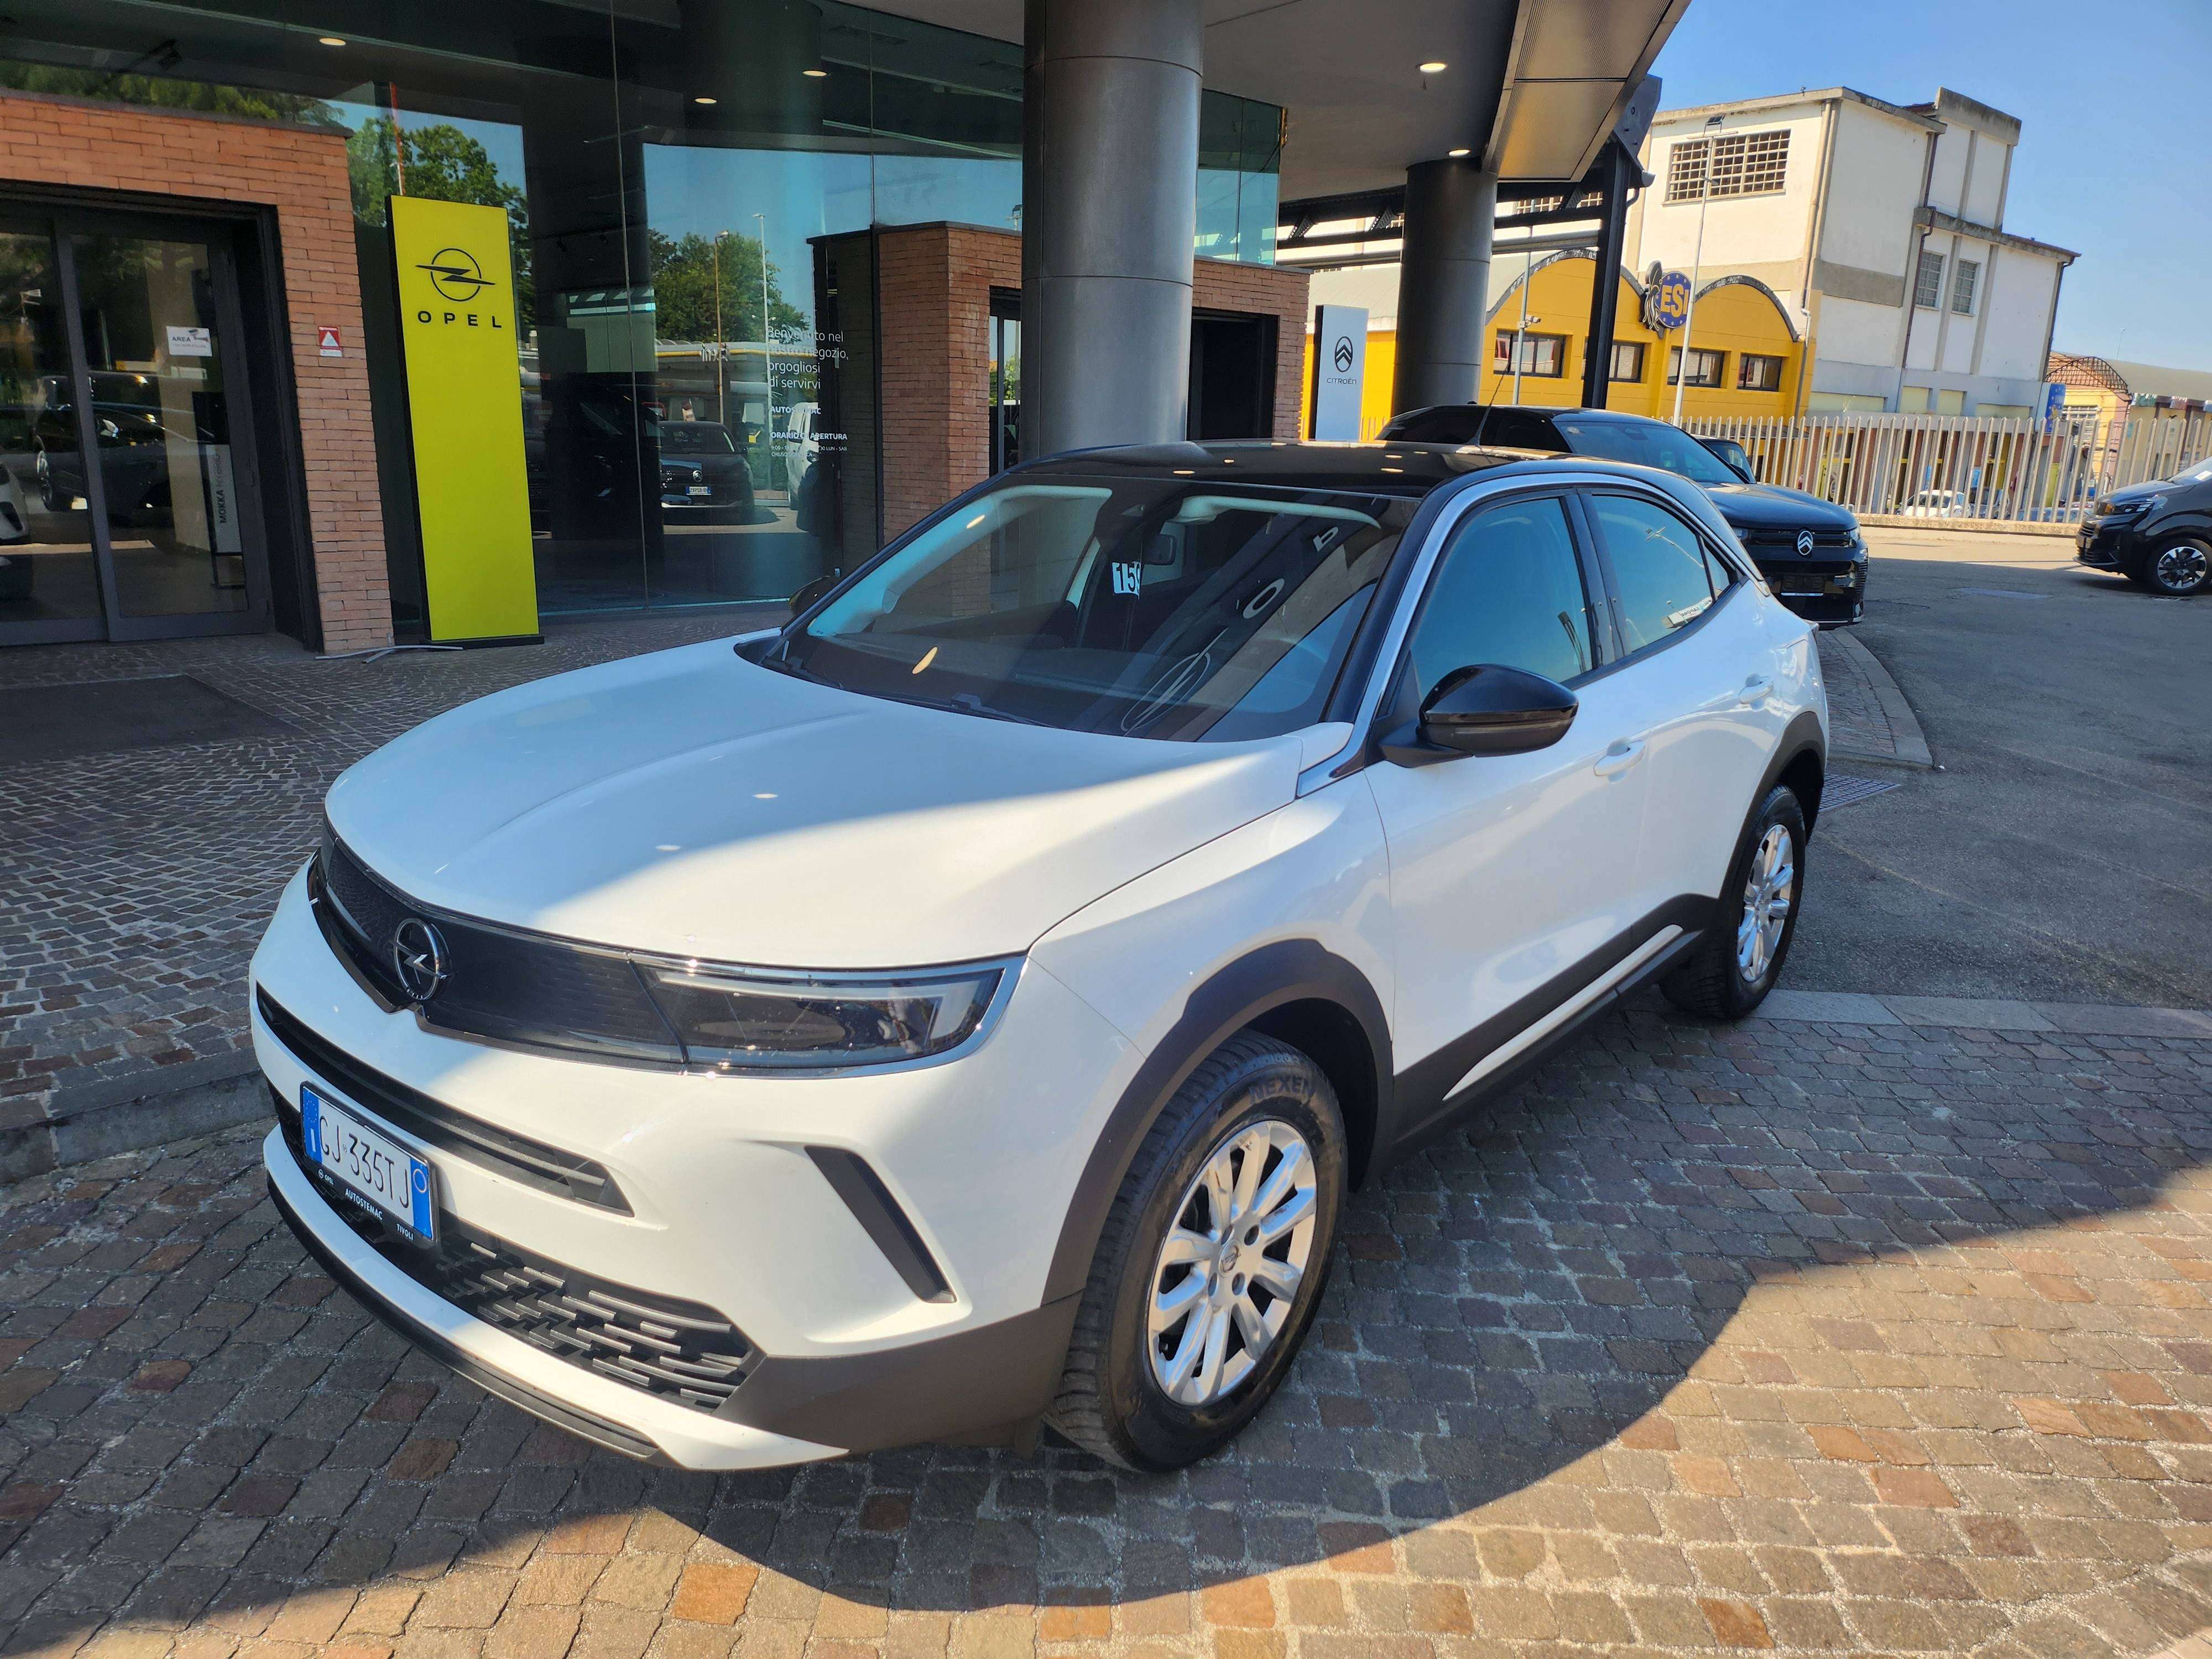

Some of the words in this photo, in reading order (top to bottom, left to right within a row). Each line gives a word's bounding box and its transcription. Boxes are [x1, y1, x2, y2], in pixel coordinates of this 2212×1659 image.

[1661, 283, 1689, 317] ESI
[418, 310, 502, 328] OPEL
[828, 331, 844, 342] nel
[768, 361, 821, 374] orgogliosi
[769, 377, 778, 388] di
[781, 379, 821, 389] servirvi
[771, 406, 822, 415] AUTOSAC
[216, 489, 227, 523] MOKKA
[1249, 1074, 1315, 1102] NEXEN
[325, 1174, 334, 1185] OPEL
[345, 1188, 383, 1220] AUTOSTEMAC
[397, 1223, 414, 1241] TIVOLI
